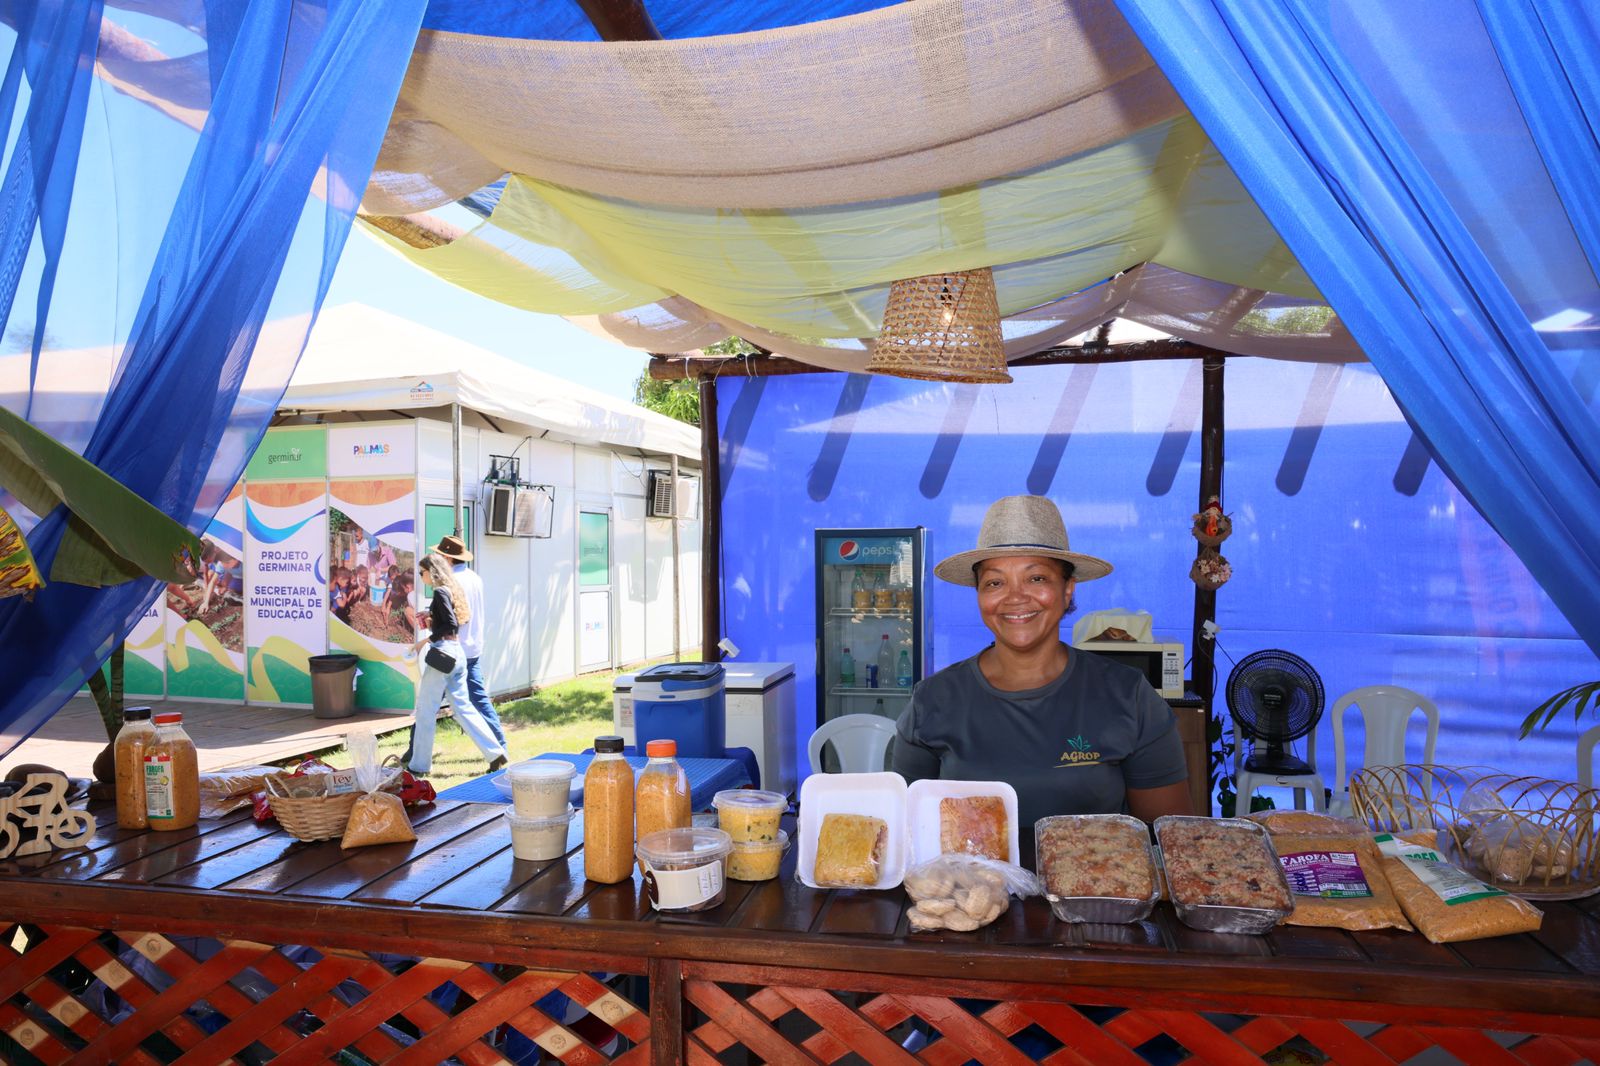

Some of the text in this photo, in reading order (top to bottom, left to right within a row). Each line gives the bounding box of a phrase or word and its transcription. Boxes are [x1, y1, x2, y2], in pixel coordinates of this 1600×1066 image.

[353, 443, 390, 455] PALMAS
[261, 551, 309, 560] PROJETO
[258, 562, 312, 572] GERMINAR
[254, 585, 317, 596] SECRETARIA
[250, 597, 322, 608] MUNICIPAL DE
[257, 607, 313, 620] EDUCAÇÃO
[1060, 751, 1101, 762] AGROP
[1280, 853, 1329, 866] FAROFA
